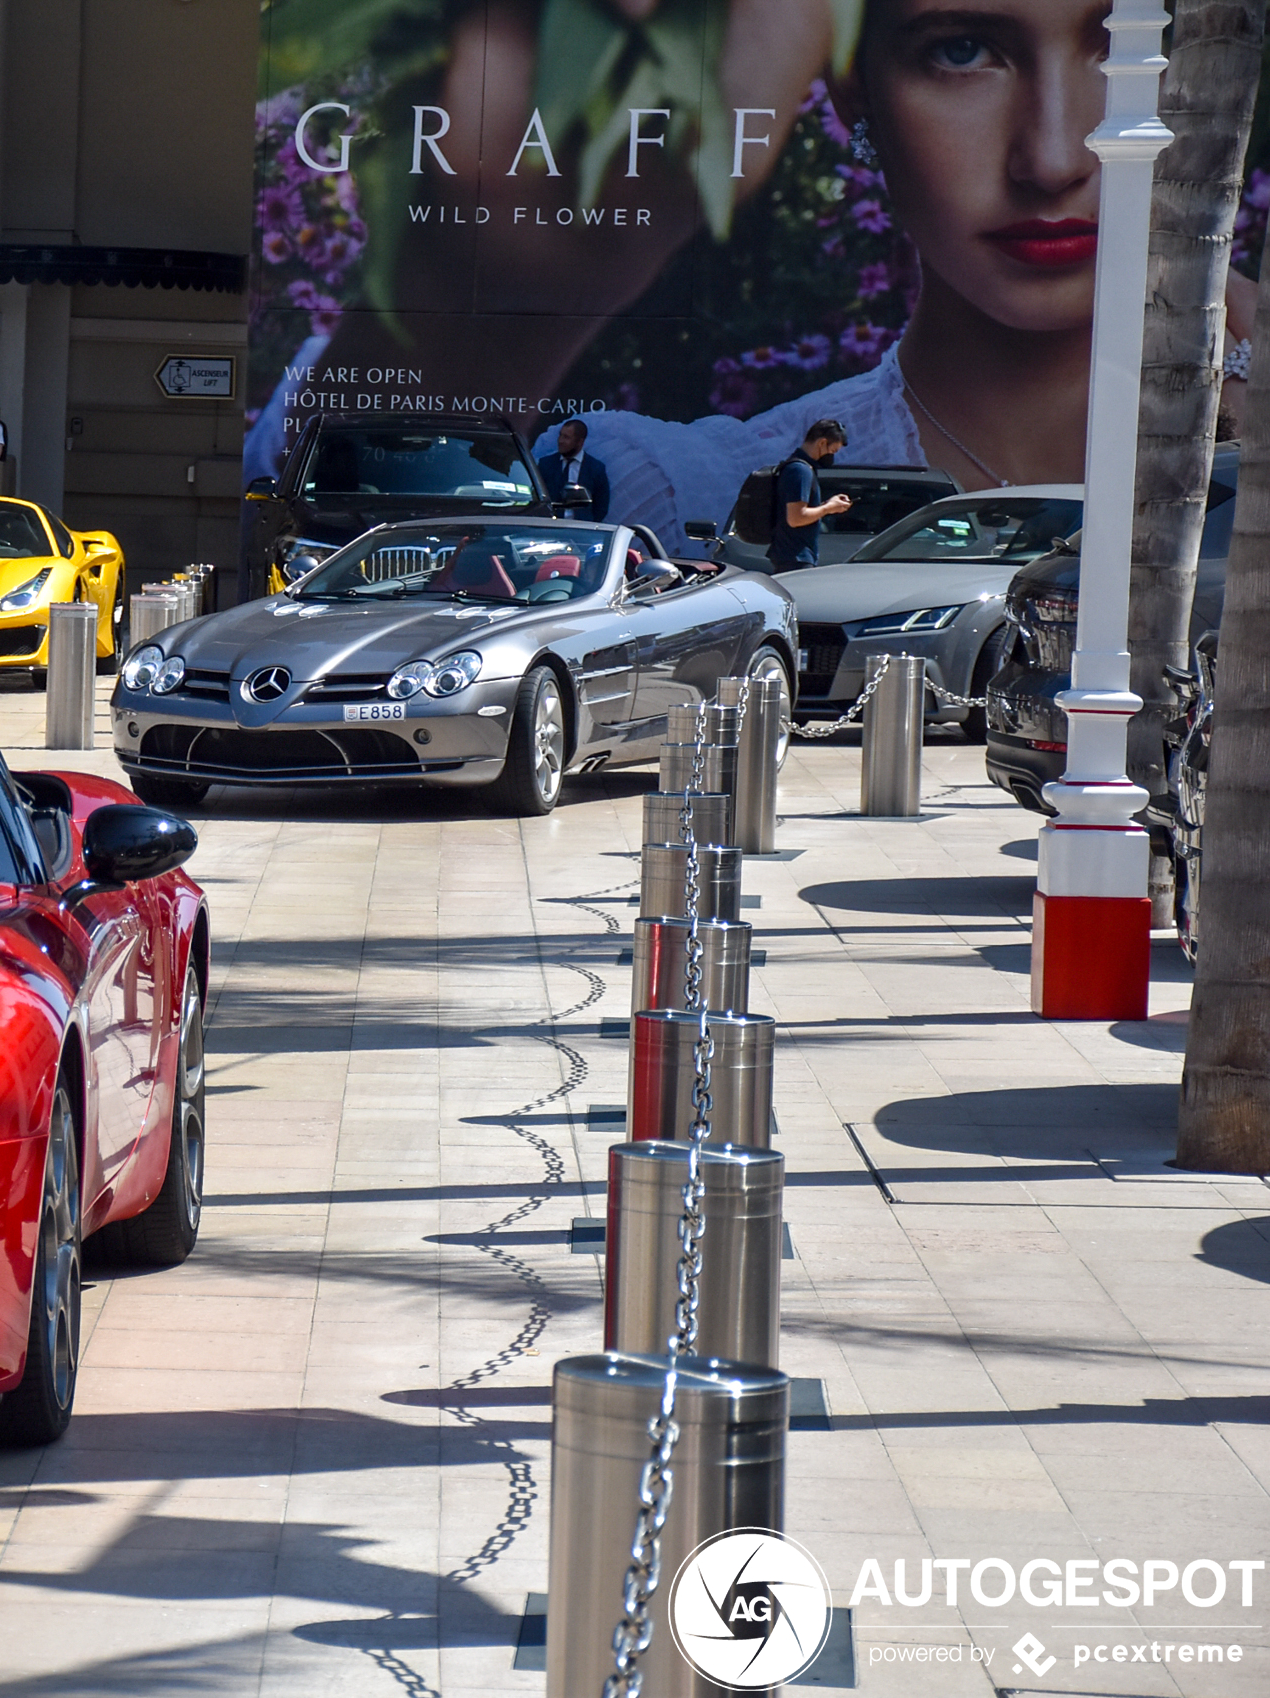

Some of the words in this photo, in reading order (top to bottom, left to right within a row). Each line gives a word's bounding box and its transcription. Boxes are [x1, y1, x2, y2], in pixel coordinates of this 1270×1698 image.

[294, 102, 777, 178] GRAFF
[409, 205, 490, 224] WILD
[514, 207, 652, 226] FLOWER
[192, 370, 229, 378] ASCENSEUR
[284, 366, 315, 382] WE
[322, 367, 359, 383] ARE
[366, 368, 422, 384] OPEN
[284, 388, 349, 409] HÔTEL
[357, 394, 382, 410] DE
[390, 395, 444, 412] PARIS
[452, 397, 606, 414] MONTE-CARLO
[360, 705, 402, 719] E858
